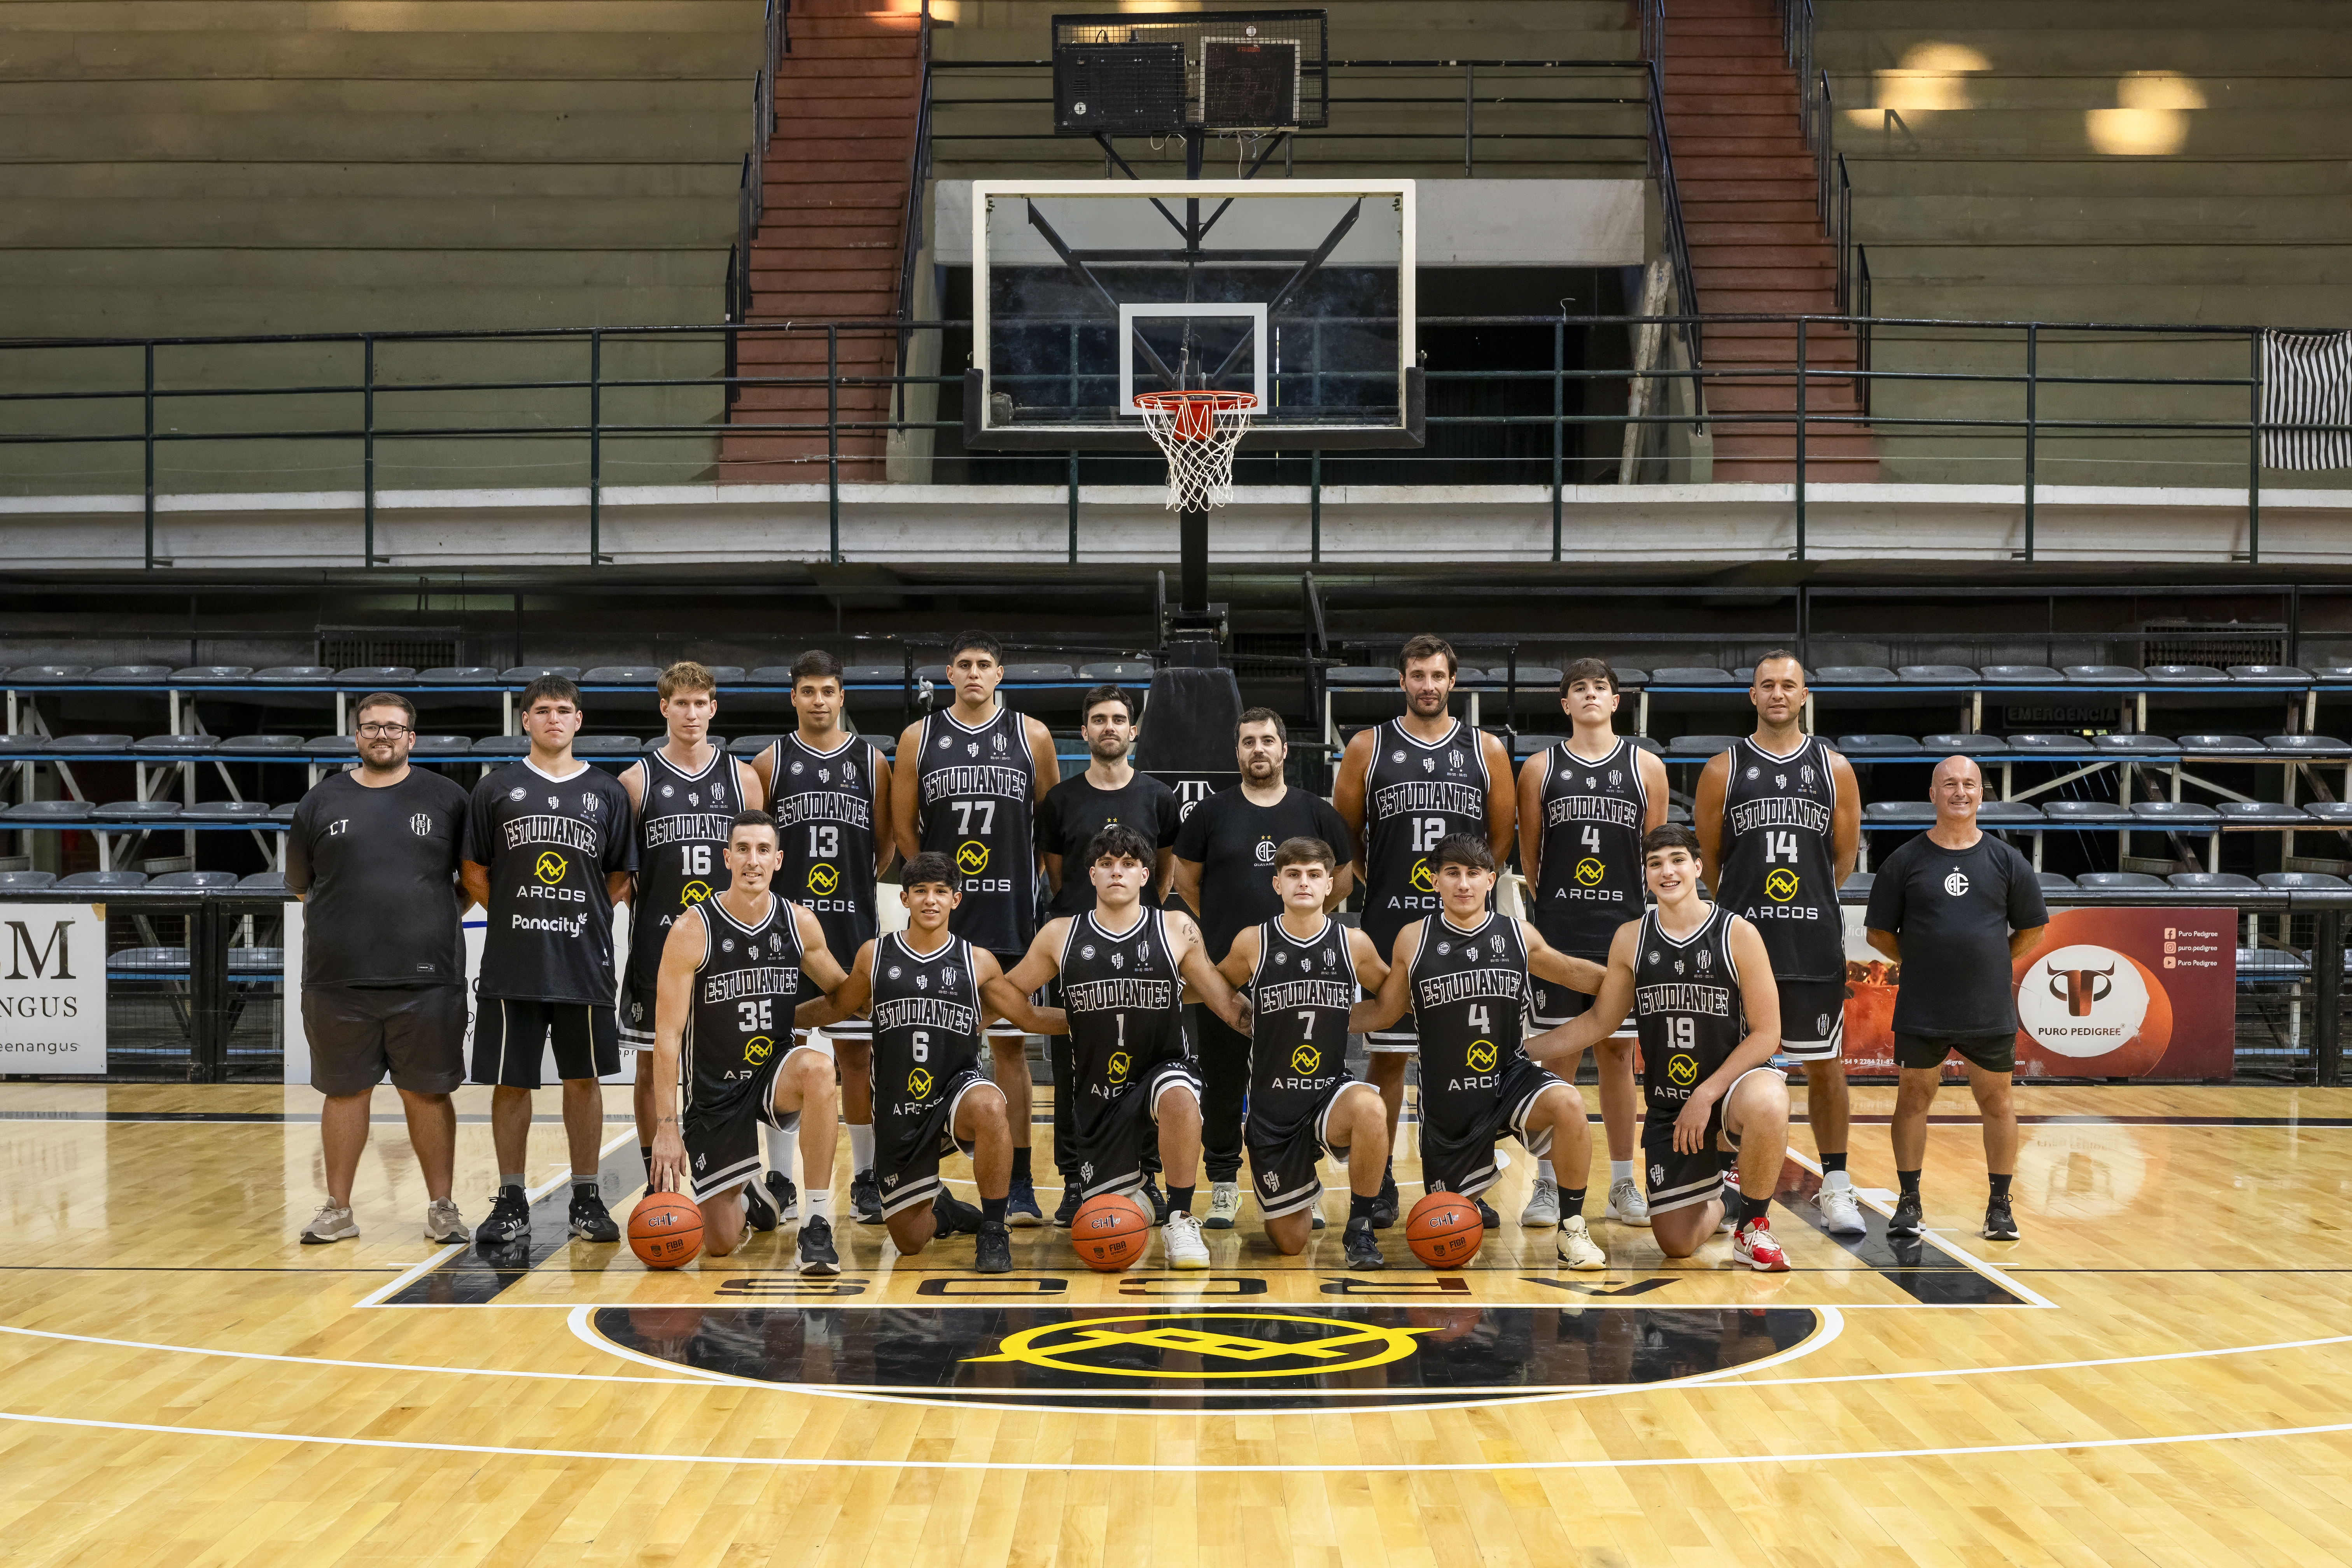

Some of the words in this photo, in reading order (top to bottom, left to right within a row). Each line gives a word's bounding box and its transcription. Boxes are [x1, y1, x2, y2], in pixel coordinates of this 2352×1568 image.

[922, 765, 1027, 806] ESTUDIANTES
[1375, 781, 1482, 821] ESTUDIANTES
[776, 791, 870, 830] ESTUDIANTES
[952, 800, 995, 835] 77
[1548, 795, 1637, 830] ESTUDIANTES
[1731, 797, 1830, 837] ESTUDIANTES
[330, 819, 349, 836] CT
[503, 815, 597, 858] ESTUDIANTES
[646, 814, 735, 849] ESTUDIANT
[809, 825, 838, 858] 13
[1412, 817, 1446, 851] 12
[1581, 825, 1600, 853] 4
[681, 845, 711, 875] 16
[1766, 831, 1799, 863] 14
[516, 886, 586, 903] ARCOS
[958, 880, 1010, 891] COS
[1555, 887, 1624, 901] ARCOS
[794, 900, 855, 912] RCOS
[1388, 896, 1444, 909] ARC
[1744, 906, 1819, 920] ARCOS
[512, 914, 580, 938] Panacity
[705, 967, 799, 1004] ESTUDIANTES
[1066, 978, 1171, 1014] ESTUDIANTES
[1260, 979, 1352, 1014] ESTUDIANTES
[1636, 983, 1730, 1017] ESTUDIANTES
[0, 997, 77, 1017] NGUS
[738, 999, 773, 1032] 35
[875, 998, 974, 1036] ESTUDIANTES
[1468, 1003, 1491, 1034] 4
[1116, 1013, 1125, 1046] 1
[1298, 1011, 1315, 1040] 7
[1666, 1017, 1695, 1049] 19
[2038, 1027, 2067, 1036] PURO
[2071, 1027, 2121, 1036] PEDIGREE
[912, 1031, 929, 1062] 6
[1654, 1086, 1690, 1100] ARC
[666, 1239, 684, 1250] FIBA
[1109, 1241, 1127, 1252] FIBA
[1449, 1237, 1466, 1248] FIBA
